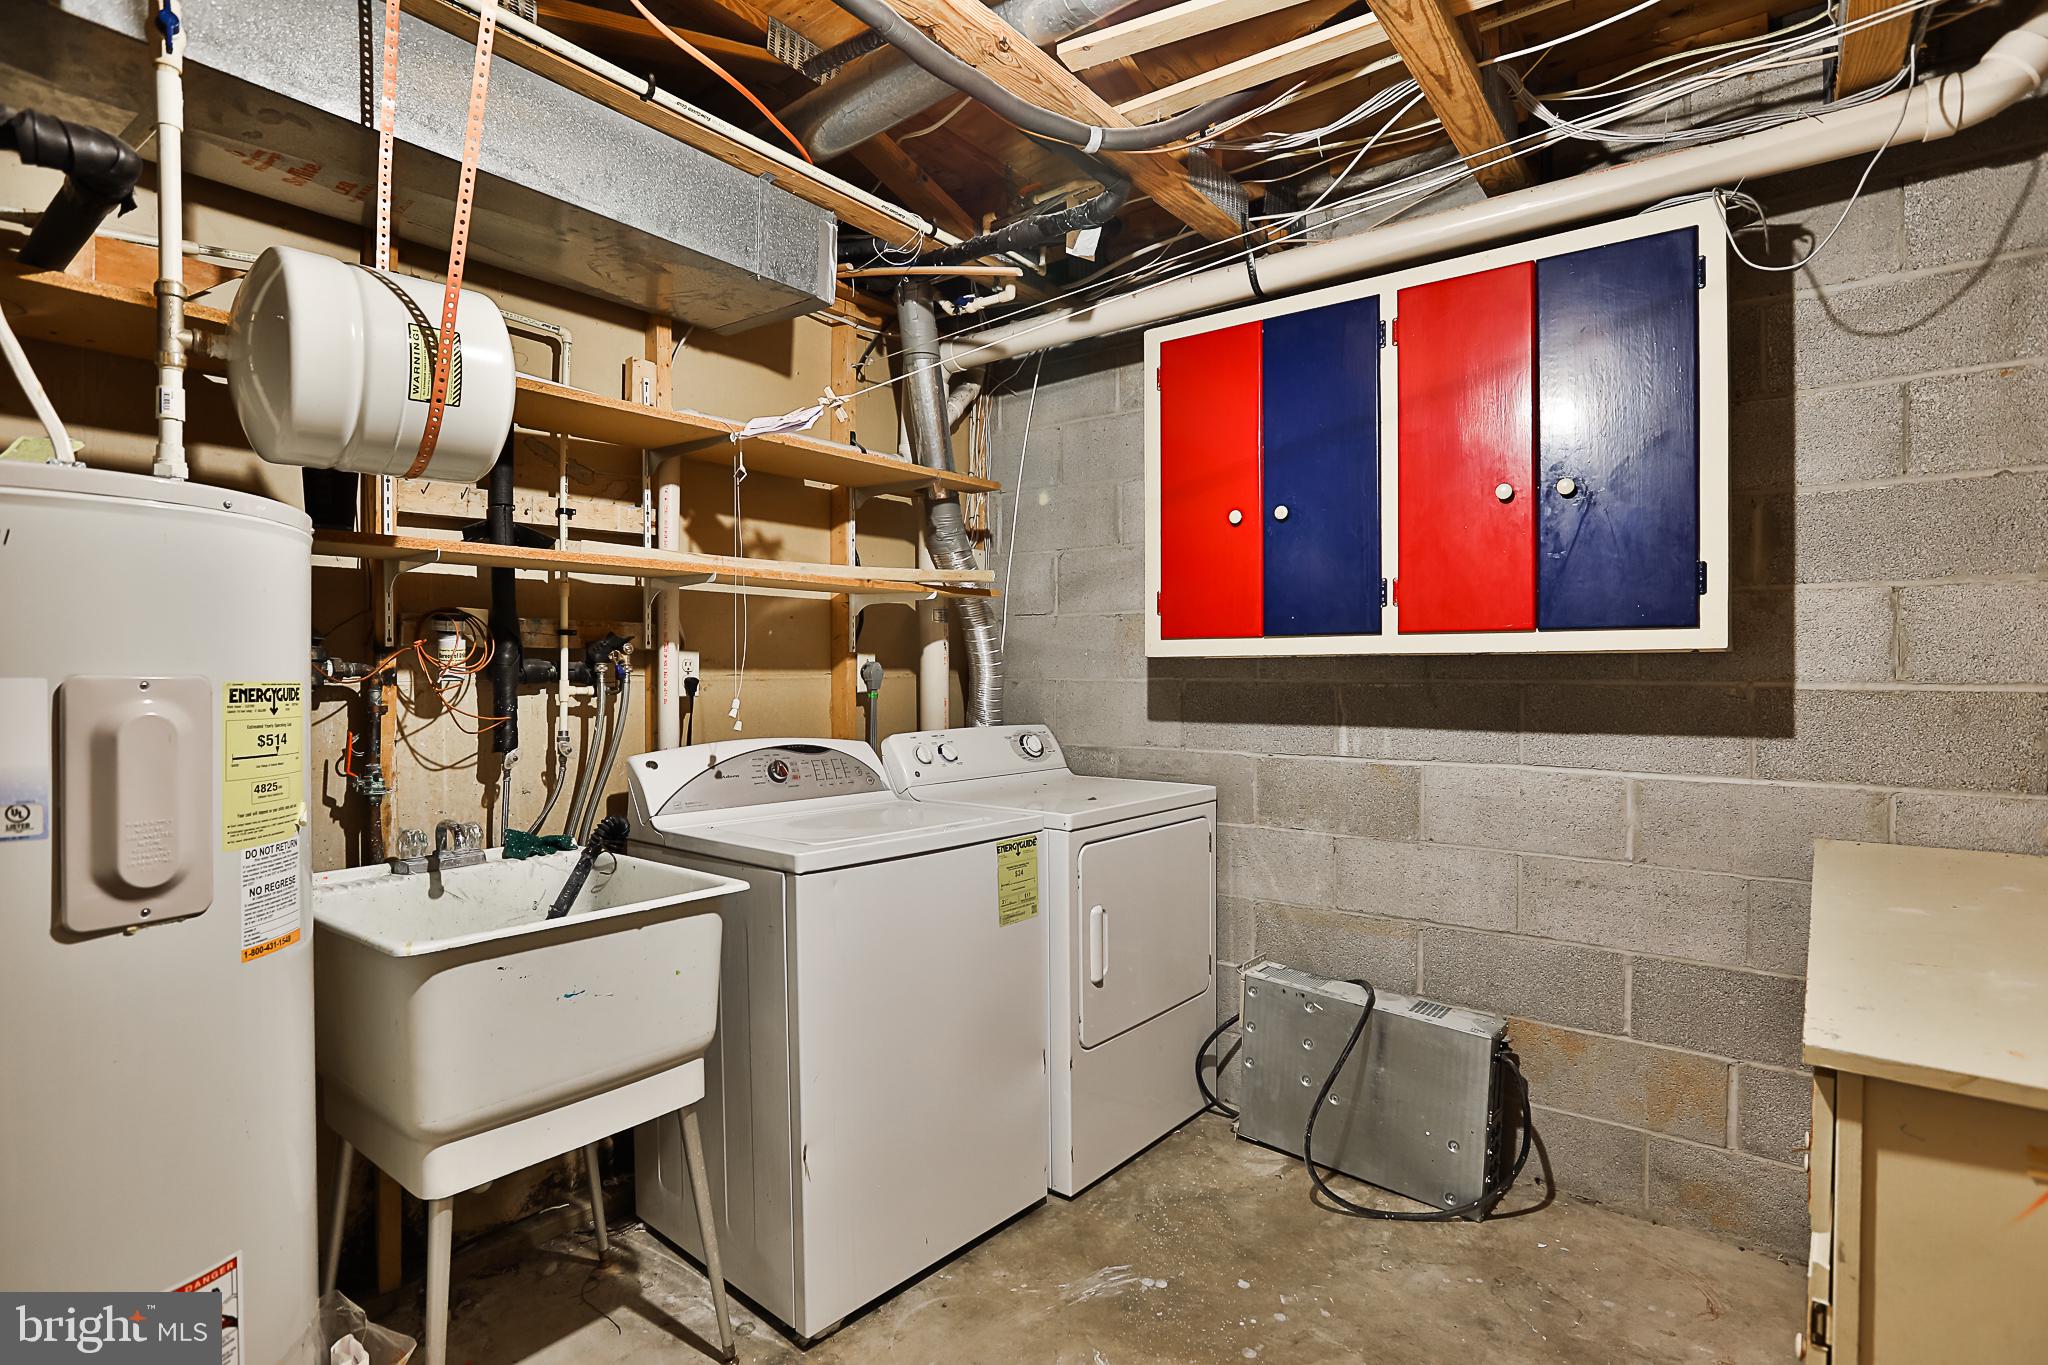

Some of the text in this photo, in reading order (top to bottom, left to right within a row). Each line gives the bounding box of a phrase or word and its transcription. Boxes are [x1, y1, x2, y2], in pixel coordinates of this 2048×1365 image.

[412, 329, 421, 395] WARNING!
[228, 687, 300, 703] ENERGYGUIDE
[257, 732, 287, 749] $514
[253, 781, 278, 794] 4825
[245, 839, 298, 860] DO NOT RETURN
[996, 839, 1037, 854] ENERGYGUIDE
[249, 875, 296, 898] NO REGRESE
[184, 1260, 234, 1293] DANGER
